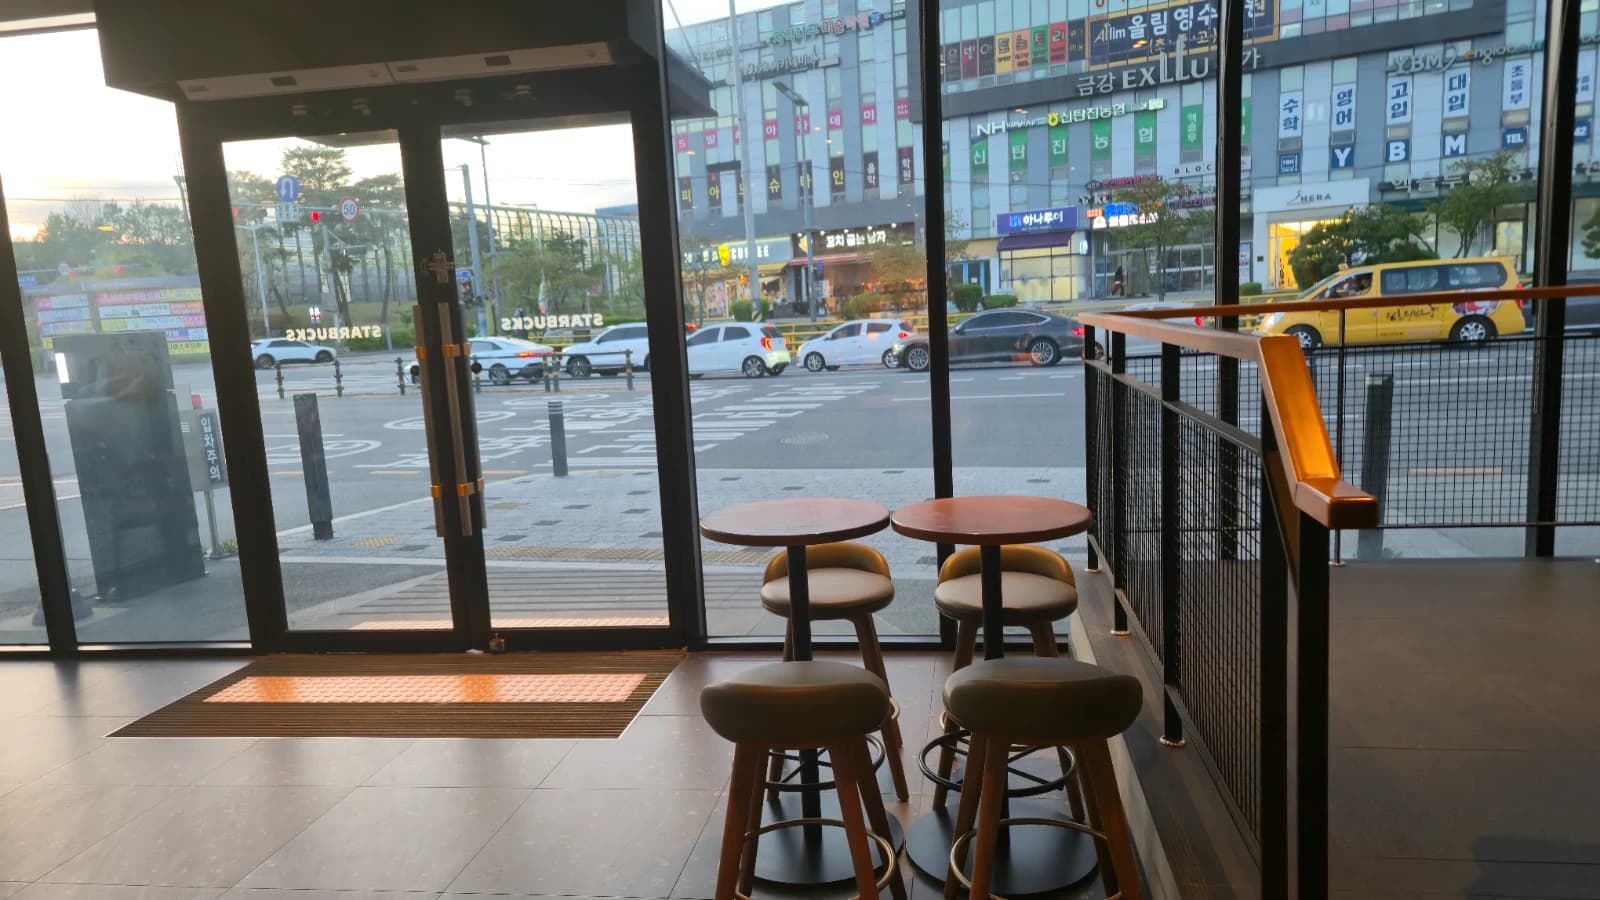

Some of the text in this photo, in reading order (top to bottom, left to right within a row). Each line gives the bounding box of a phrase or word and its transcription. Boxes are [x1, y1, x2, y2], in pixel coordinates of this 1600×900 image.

[1076, 71, 1117, 97] 금강
[1242, 47, 1261, 70] 가
[1336, 88, 1353, 126] 영어
[1391, 80, 1408, 120] 고입
[1448, 73, 1467, 112] 대입
[976, 120, 1006, 136] NH
[1061, 102, 1126, 124] 신탄진농협
[1283, 98, 1300, 131] 수학
[1333, 134, 1466, 168] Y B M
[1174, 164, 1212, 175] BLOC
[343, 203, 356, 216] 50
